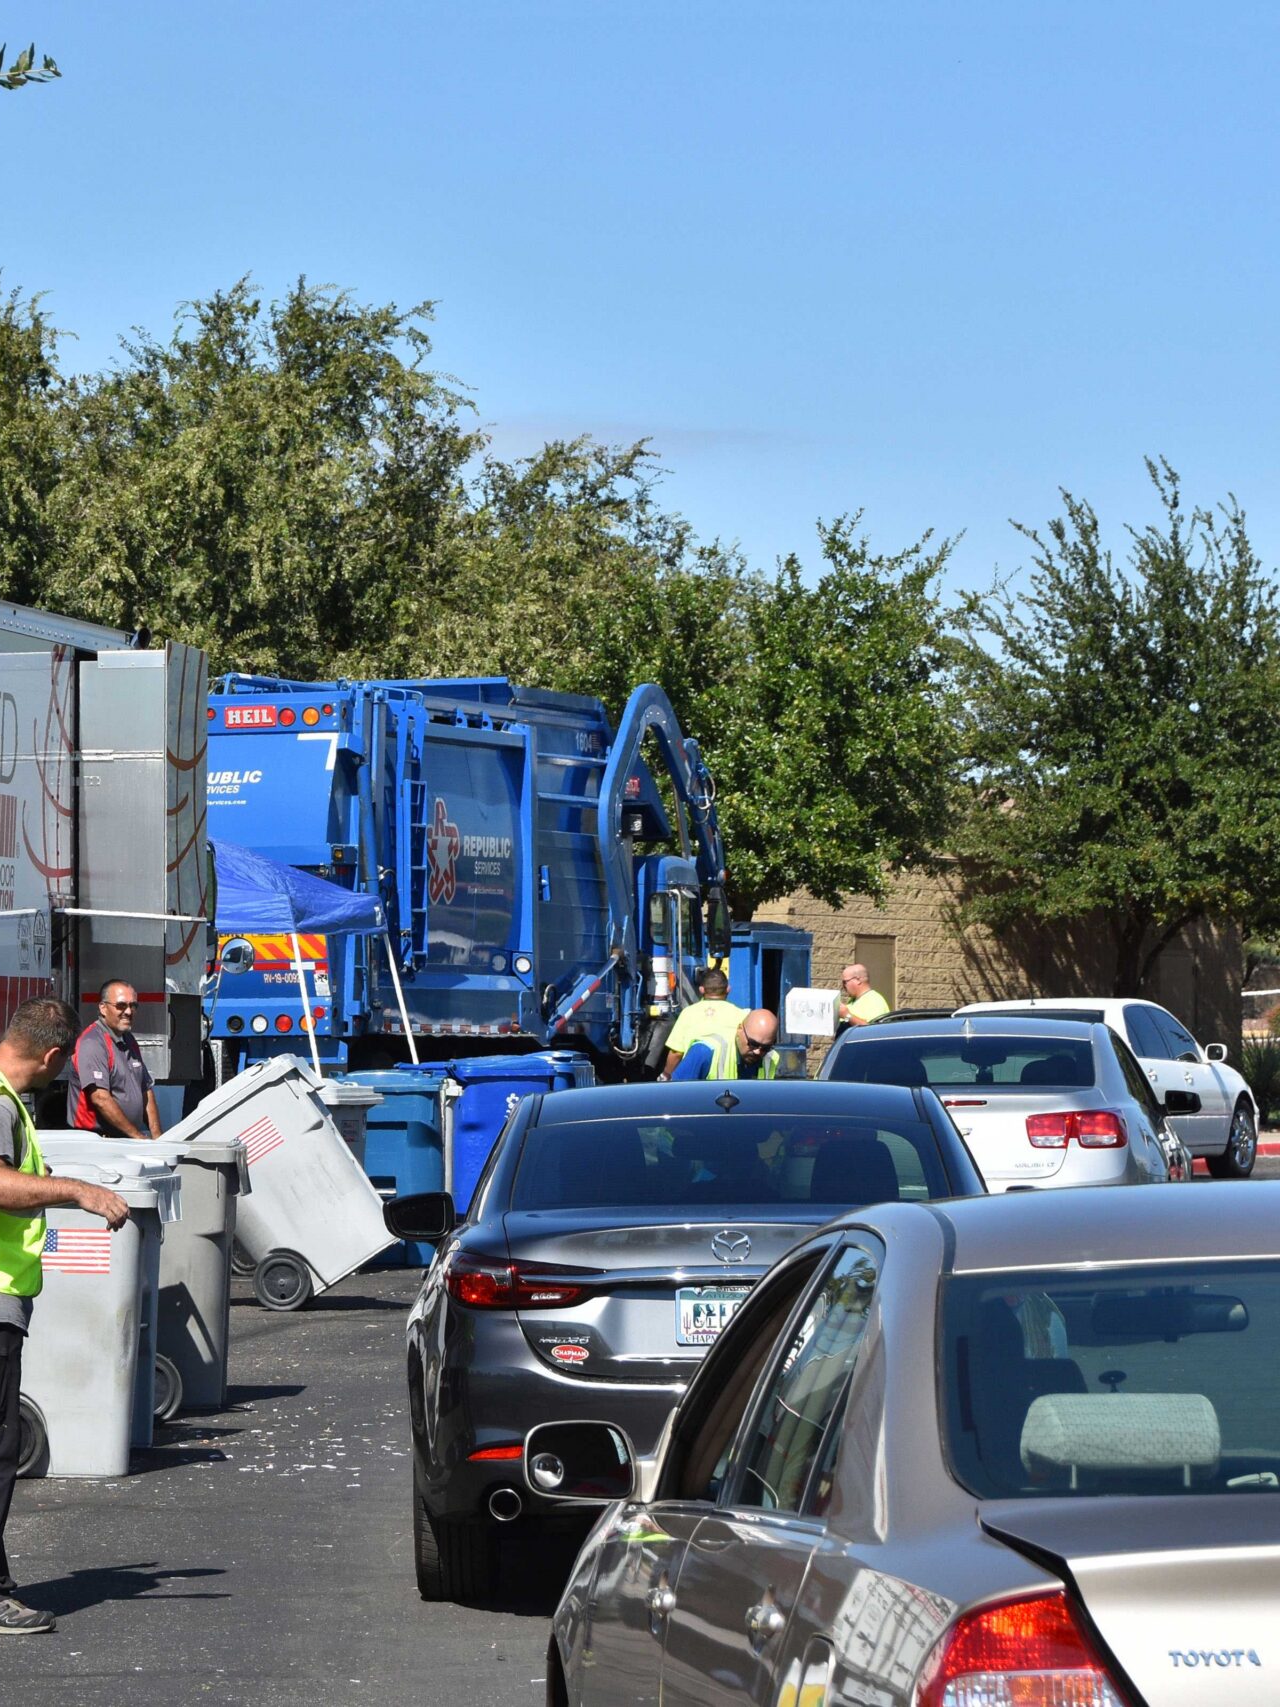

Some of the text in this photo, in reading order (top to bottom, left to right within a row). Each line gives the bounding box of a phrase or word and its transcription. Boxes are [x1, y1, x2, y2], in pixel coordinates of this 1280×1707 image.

[227, 709, 273, 724] HEIL
[207, 770, 263, 785] UBLIC
[463, 835, 511, 859] REPUBLIC
[554, 1349, 586, 1357] CHAPMAN
[1168, 1648, 1262, 1668] TOYOTA
